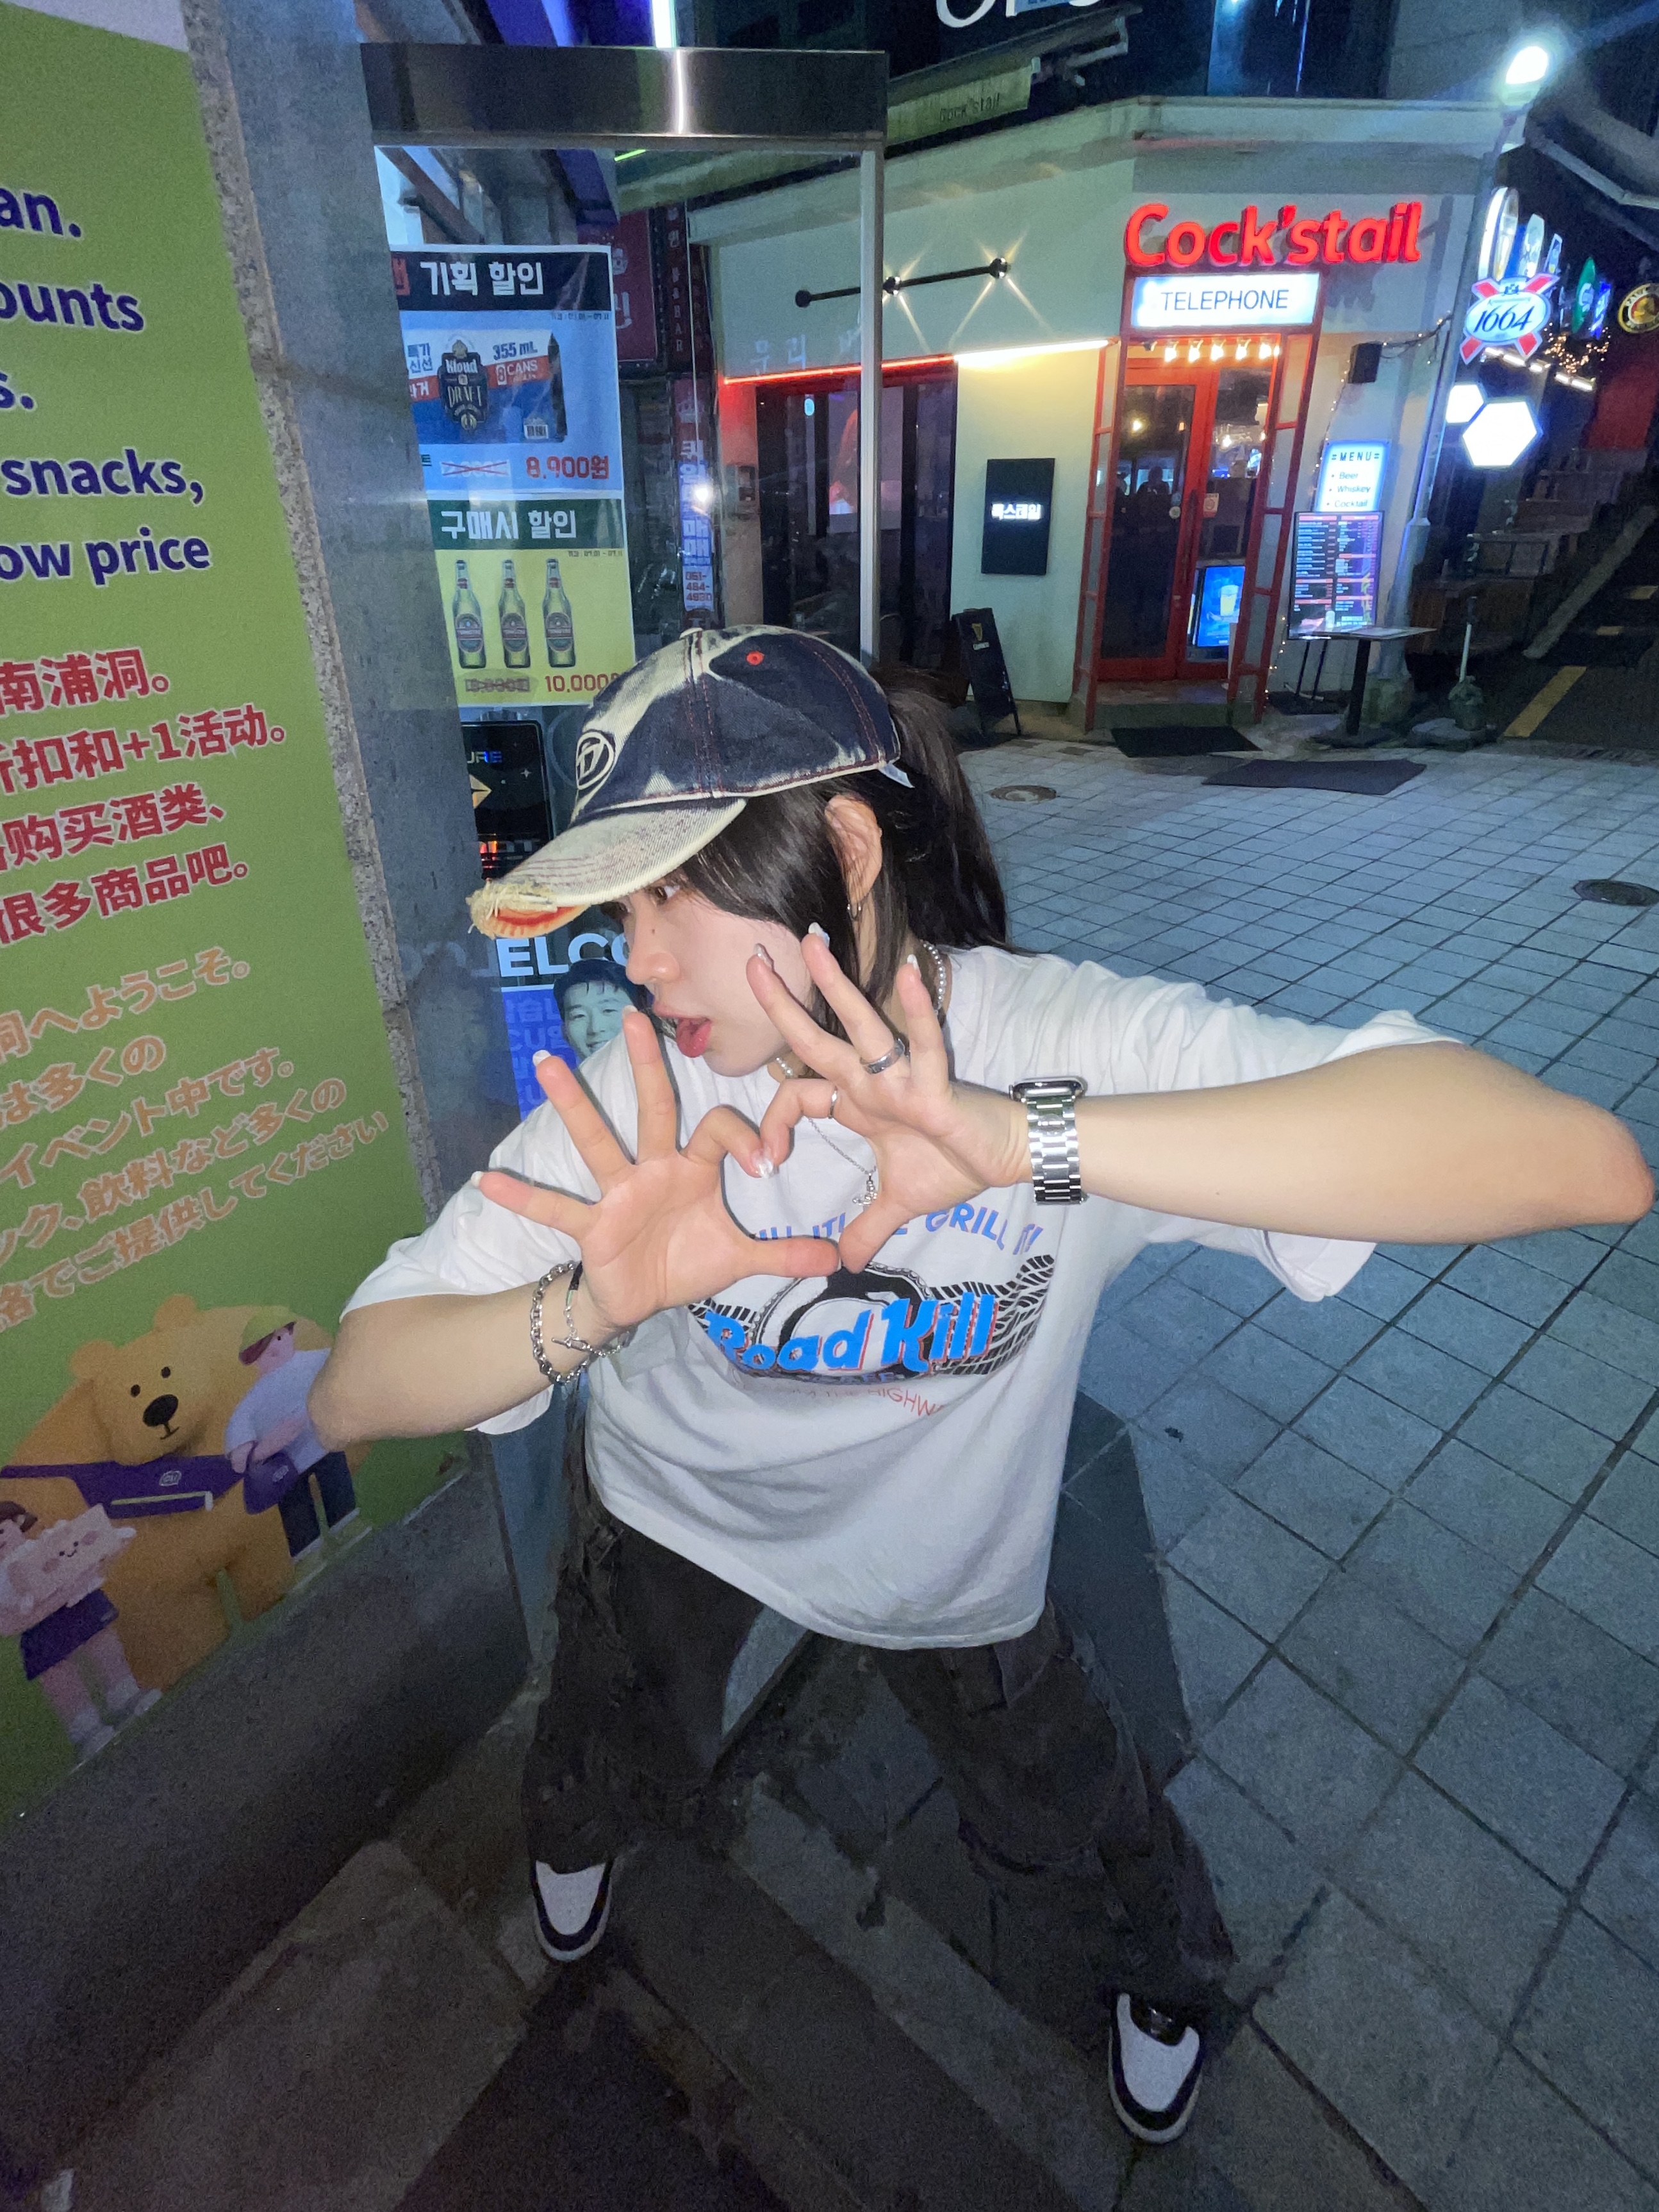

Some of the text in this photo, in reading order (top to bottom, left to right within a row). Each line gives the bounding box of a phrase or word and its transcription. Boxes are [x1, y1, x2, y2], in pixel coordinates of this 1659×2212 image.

[1125, 202, 1423, 267] Cock'stail
[420, 262, 478, 295] 기획
[488, 262, 544, 295] 할인
[1160, 290, 1289, 312] TELEPHONE
[1473, 303, 1536, 333] 1664
[445, 359, 479, 374] Kloud
[492, 342, 516, 361] 355
[507, 360, 538, 376] CANS
[1, 449, 204, 505] snacks,
[1337, 485, 1371, 494] Whiskey
[1339, 471, 1359, 479] Beer
[1334, 499, 1369, 508] Cocktail
[441, 510, 577, 540] 구매시 할인
[85, 526, 210, 585] price
[925, 1202, 1008, 1251] GRILL
[705, 1290, 1000, 1376] Road Kill
